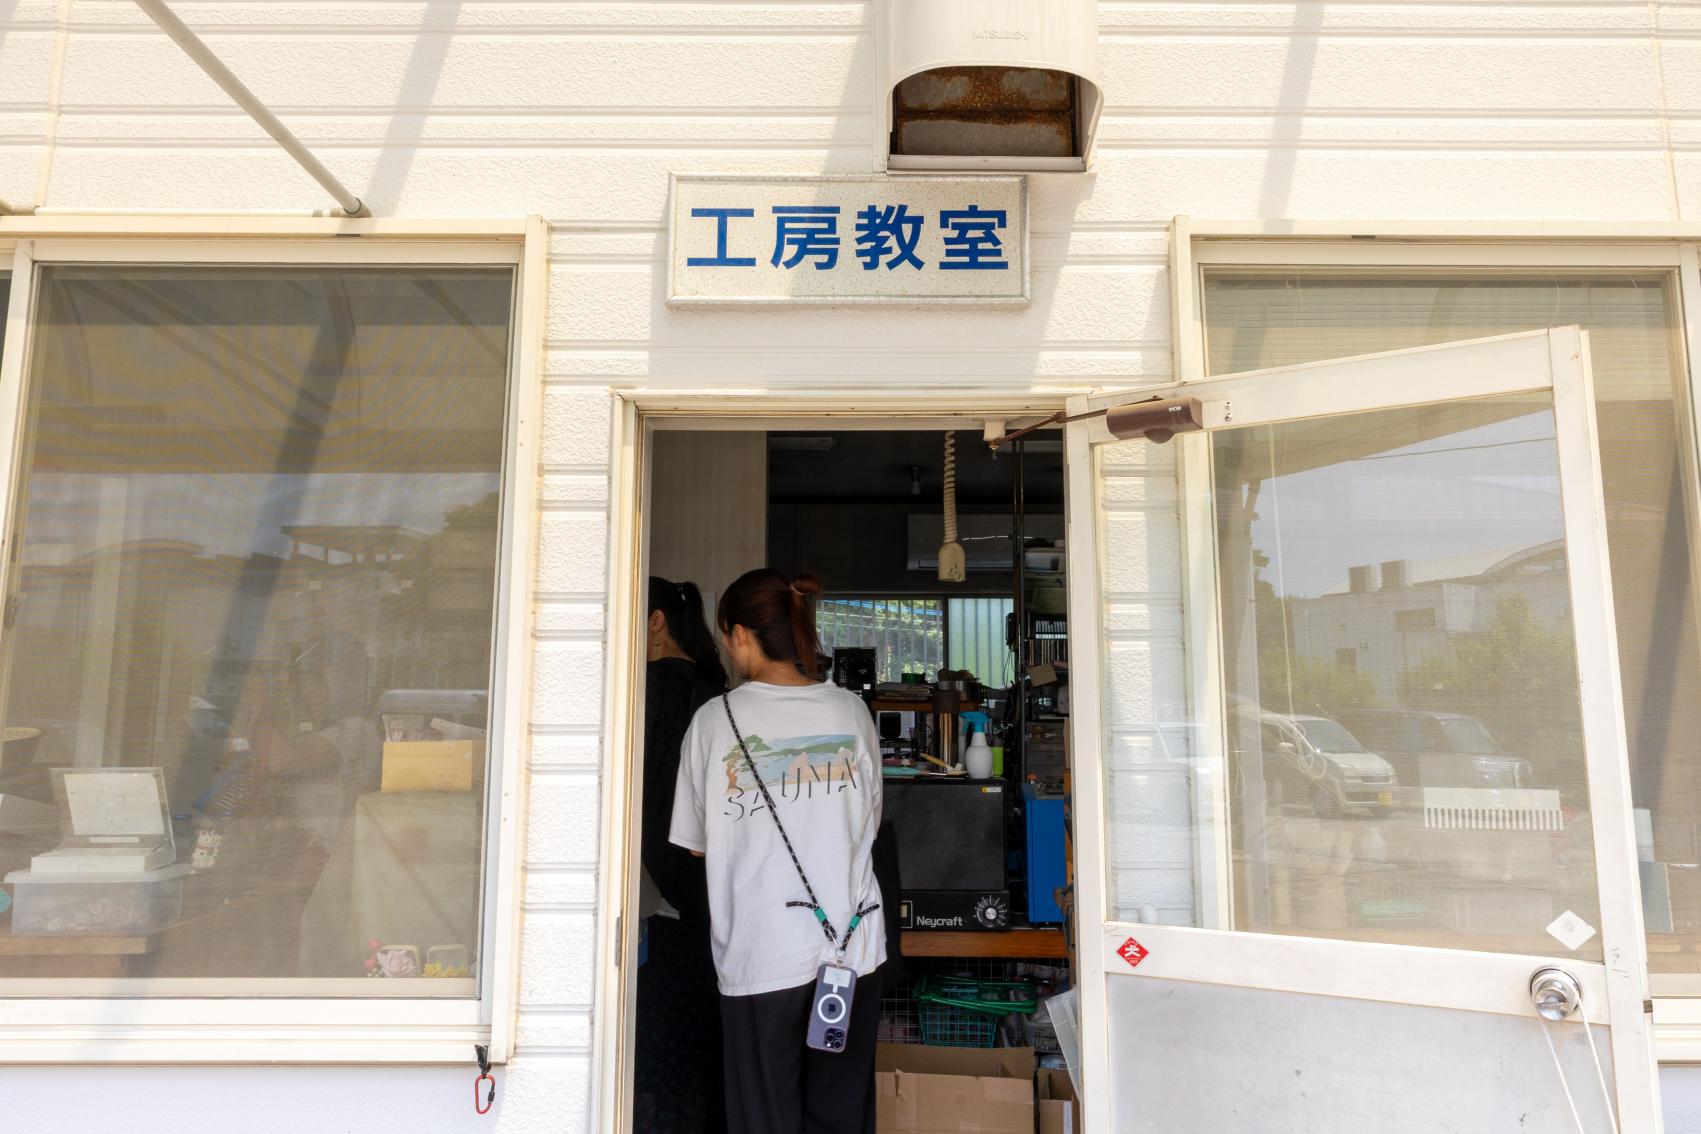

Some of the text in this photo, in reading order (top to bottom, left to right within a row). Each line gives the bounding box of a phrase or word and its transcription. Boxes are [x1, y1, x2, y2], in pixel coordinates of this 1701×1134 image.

[686, 204, 1009, 271] 工房教室
[723, 757, 857, 822] SAUNA
[916, 915, 963, 928] Neycraft
